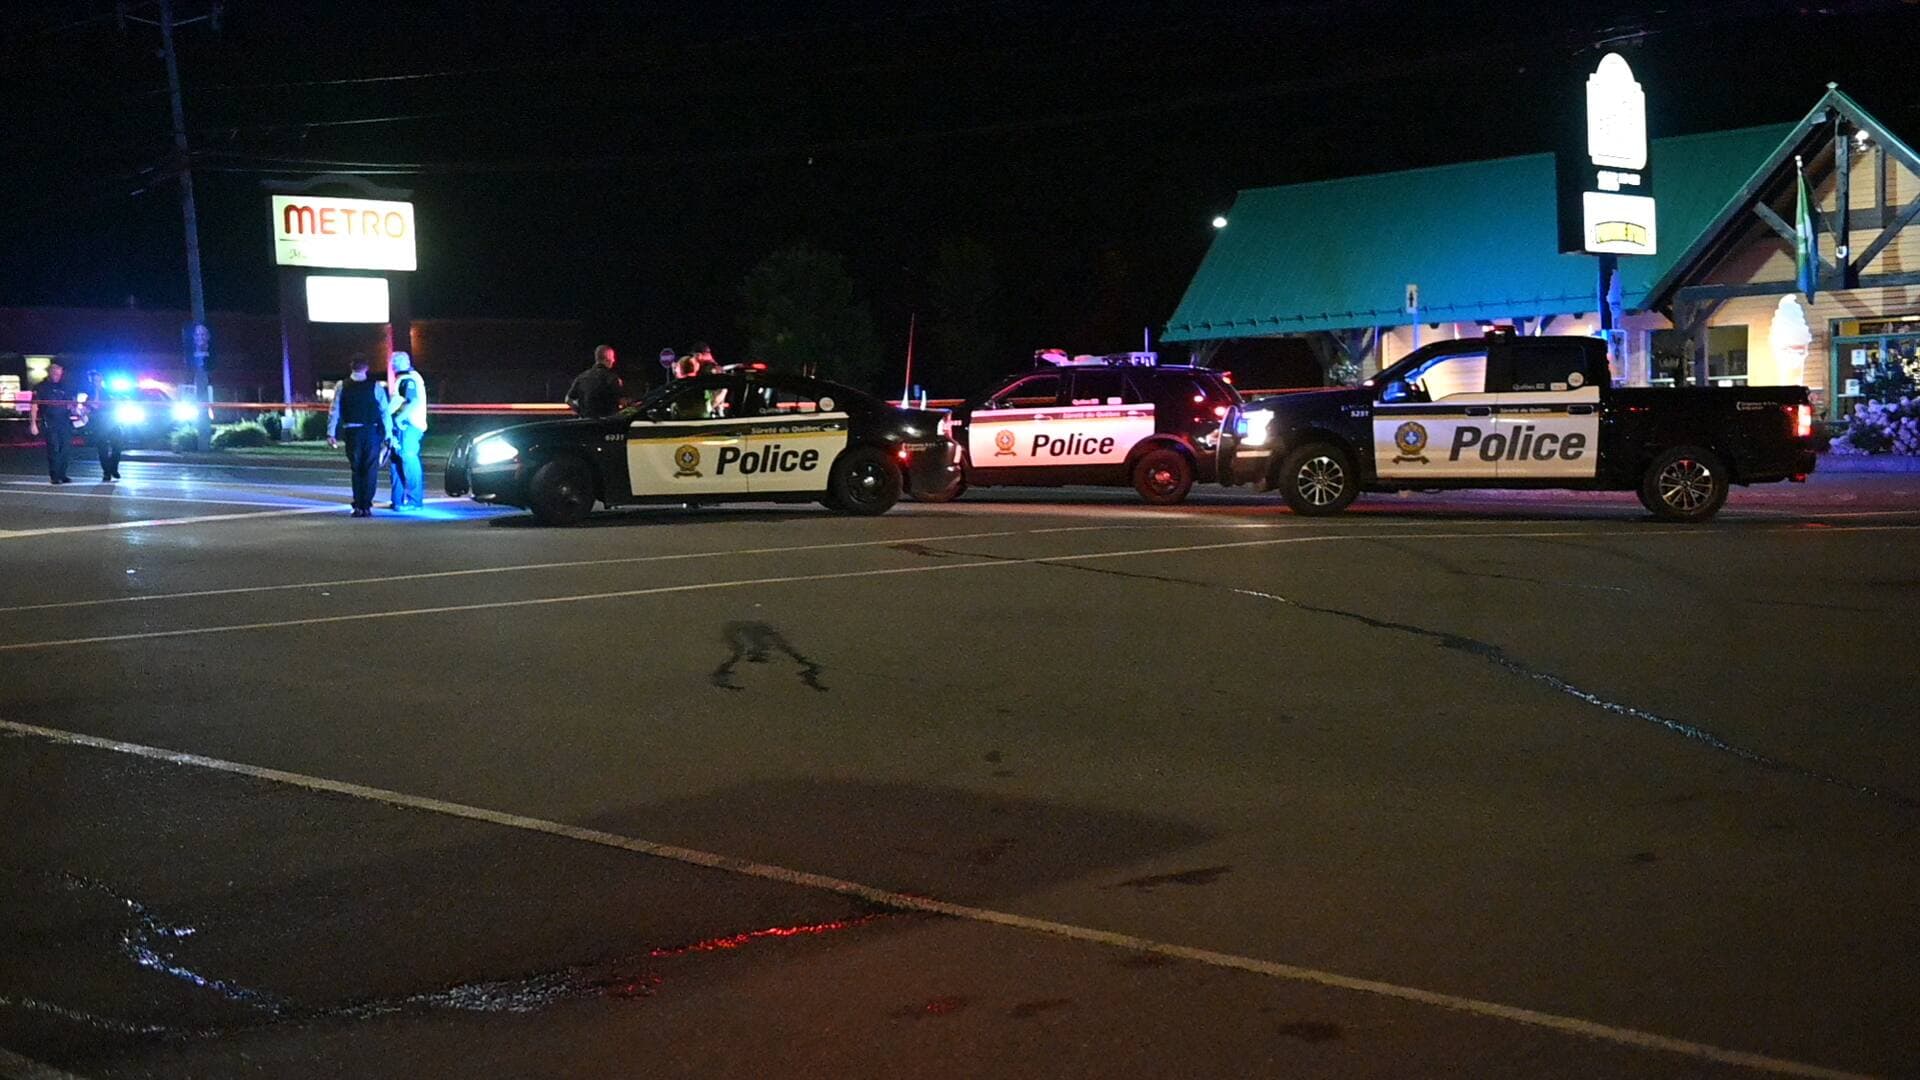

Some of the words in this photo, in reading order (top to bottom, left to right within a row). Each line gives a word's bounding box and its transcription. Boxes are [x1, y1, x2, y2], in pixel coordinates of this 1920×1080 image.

[1031, 433, 1115, 457] Police
[1449, 425, 1586, 462] Police
[716, 444, 819, 475] Police
